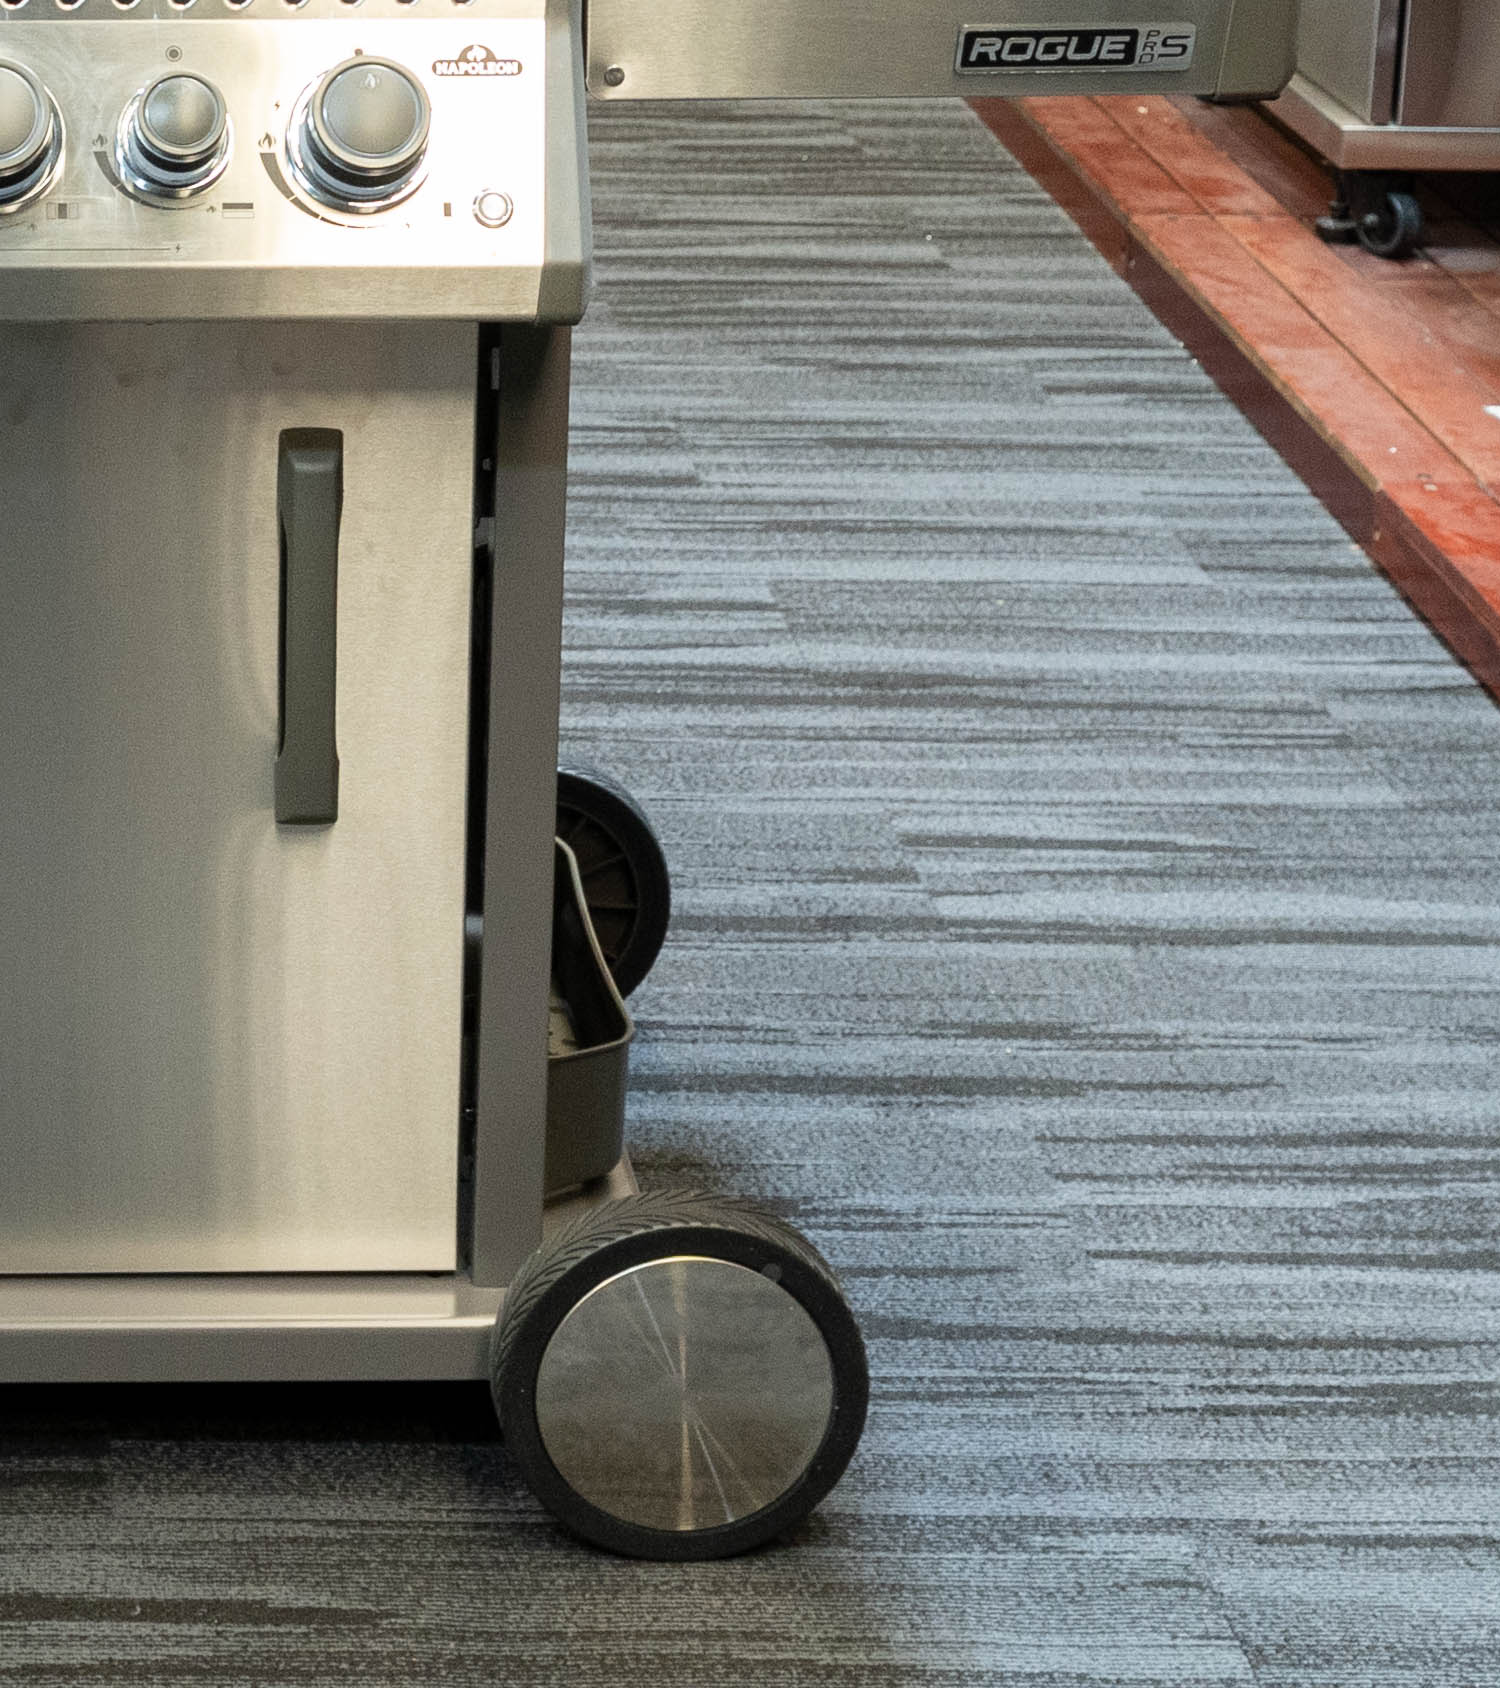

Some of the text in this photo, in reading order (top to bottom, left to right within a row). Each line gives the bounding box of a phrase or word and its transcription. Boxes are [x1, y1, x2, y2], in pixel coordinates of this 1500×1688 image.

[968, 35, 1131, 62] ROGUE
[1156, 34, 1192, 58] S
[434, 60, 520, 75] NAPOLEON
